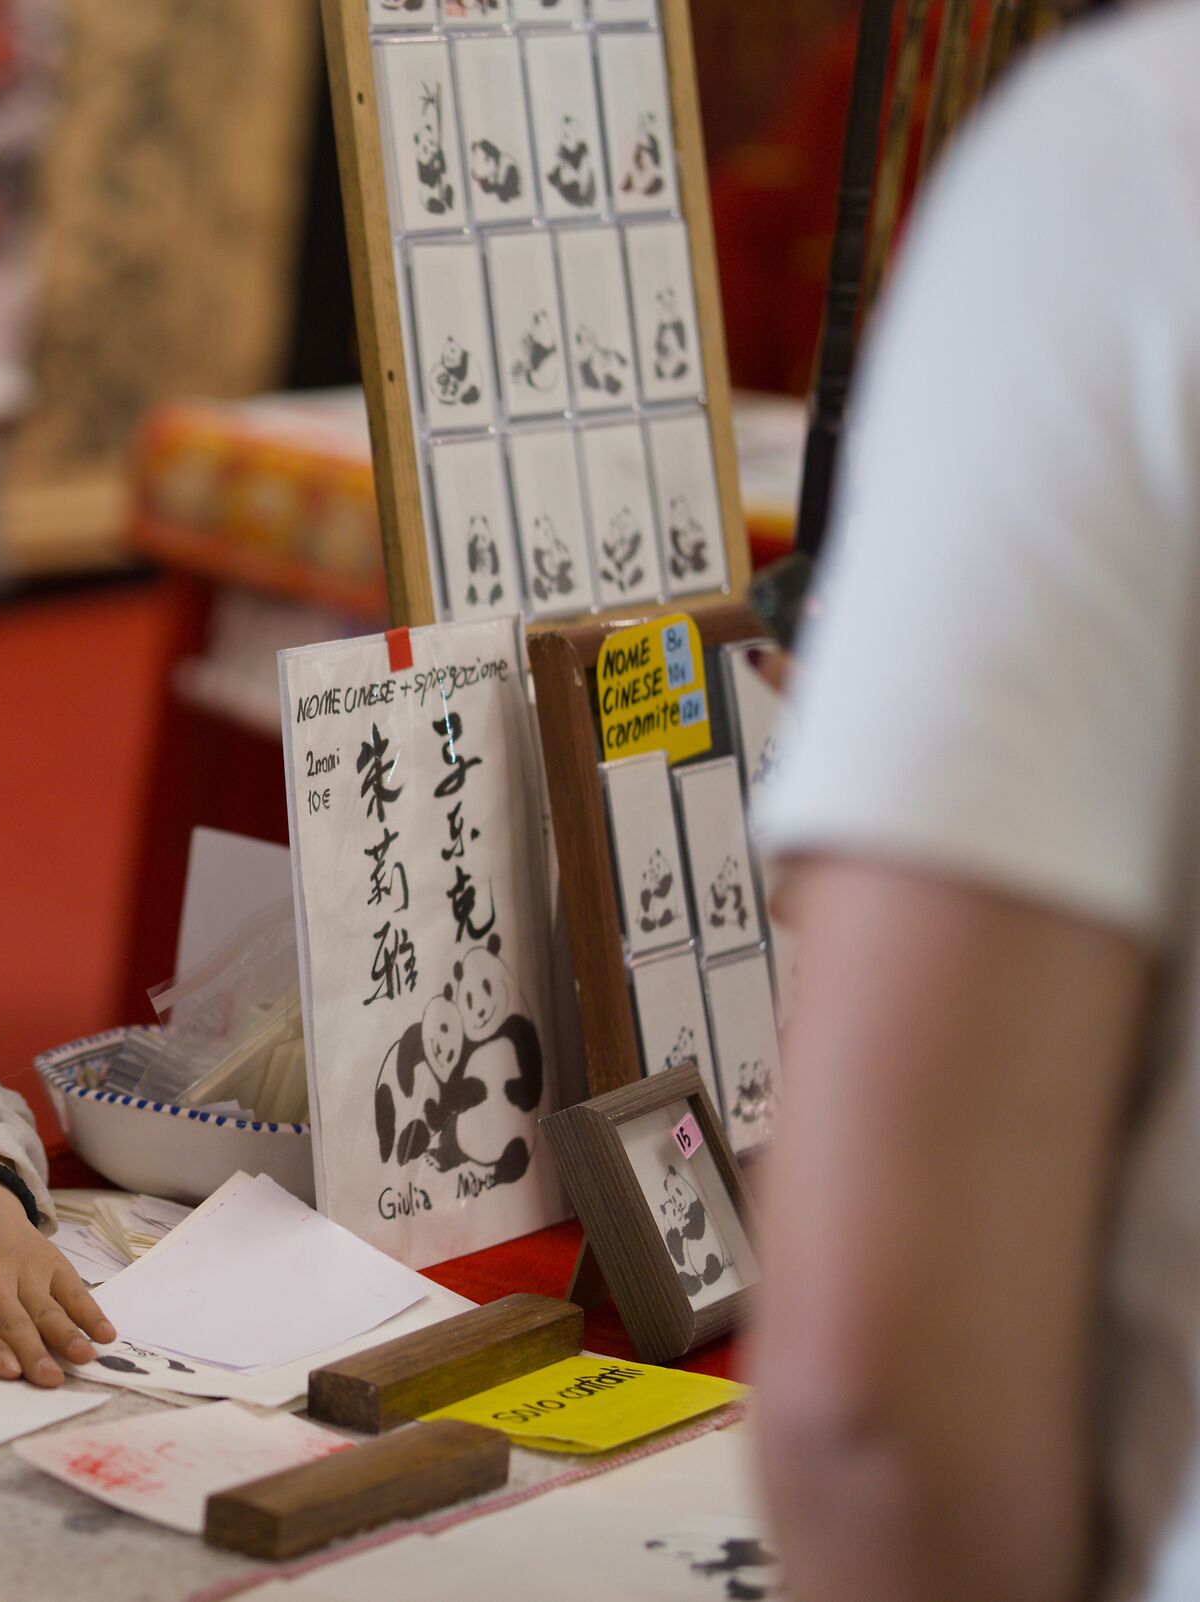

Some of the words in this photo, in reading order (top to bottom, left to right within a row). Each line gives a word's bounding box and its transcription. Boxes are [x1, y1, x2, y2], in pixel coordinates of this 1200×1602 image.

[603, 637, 650, 679] NOME
[297, 688, 341, 723] NOME
[308, 788, 331, 814] 10€
[676, 1126, 691, 1152] 15
[378, 1182, 432, 1220] Giulia
